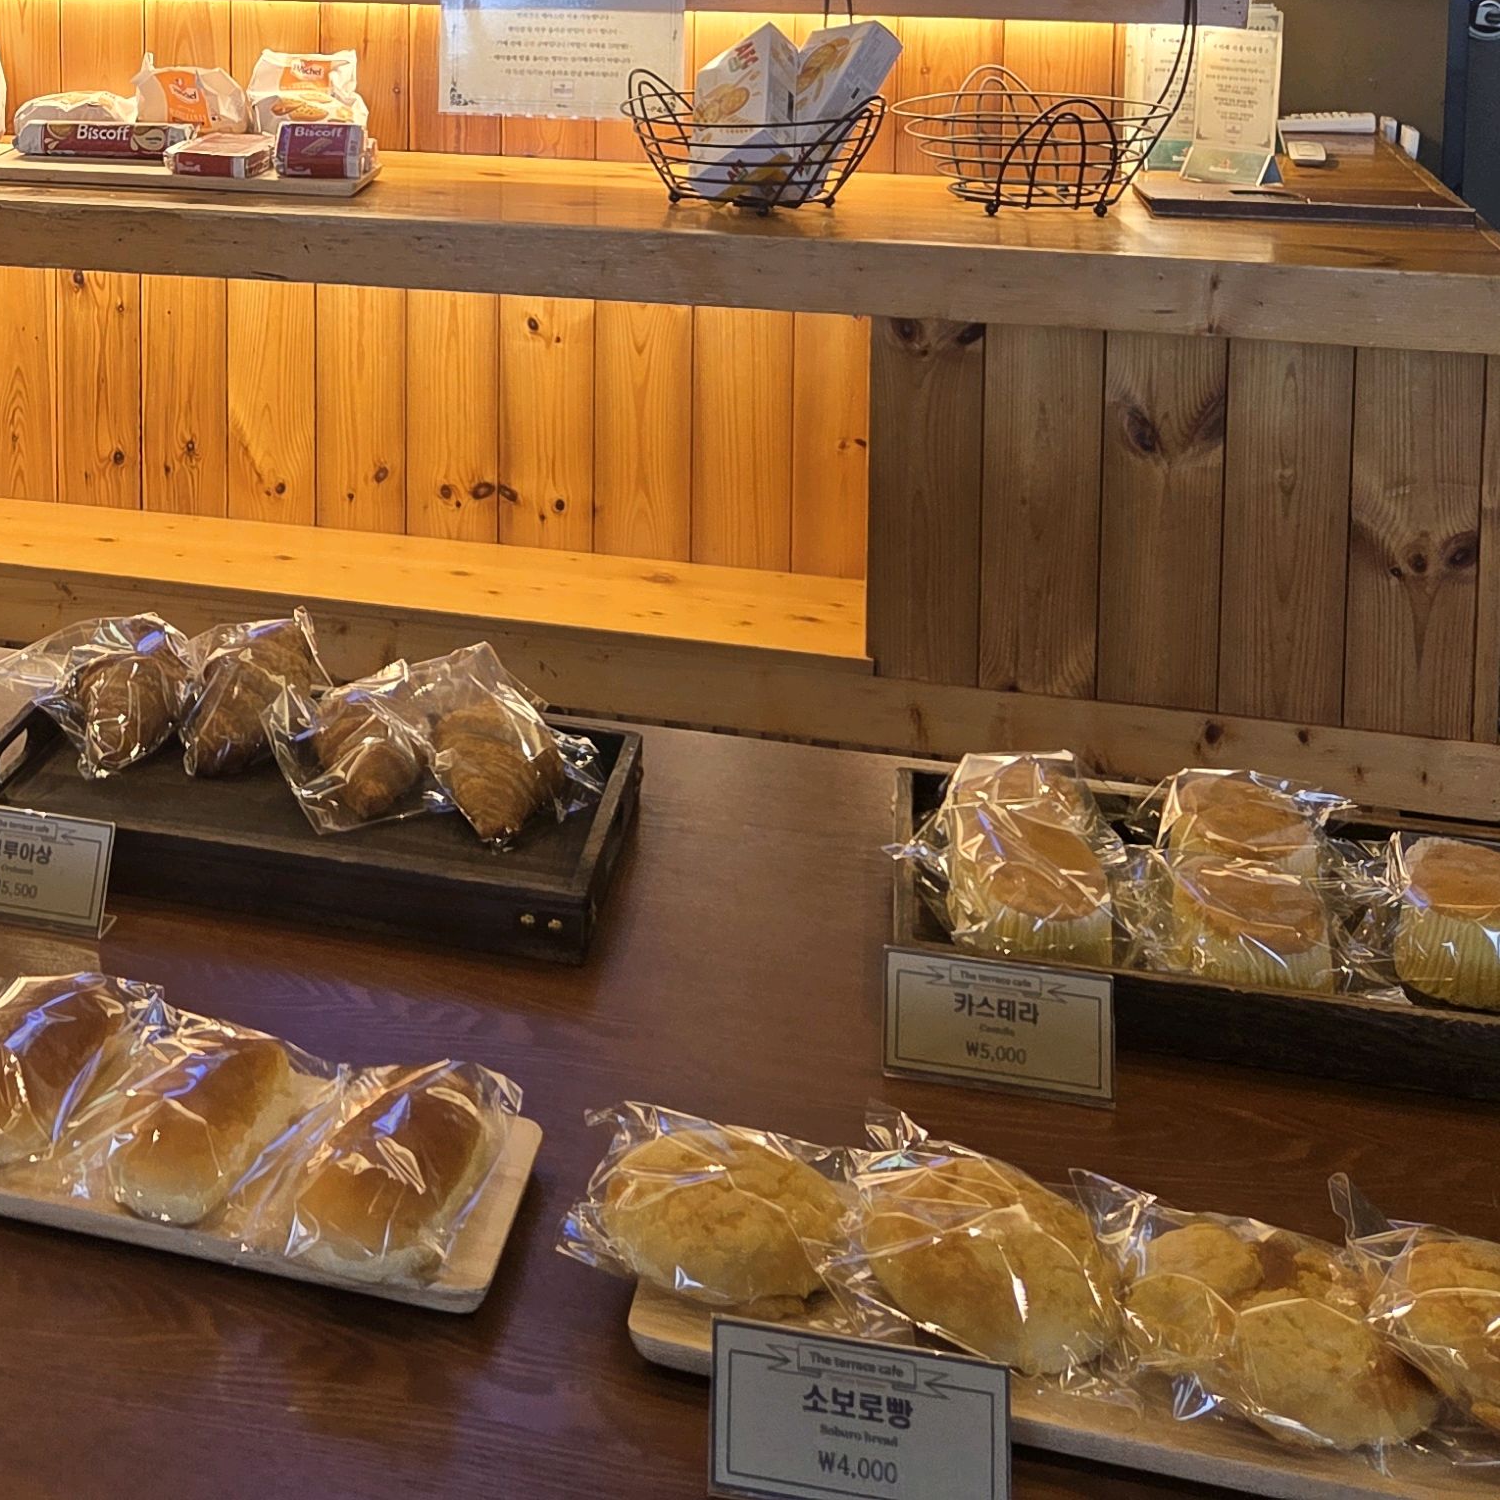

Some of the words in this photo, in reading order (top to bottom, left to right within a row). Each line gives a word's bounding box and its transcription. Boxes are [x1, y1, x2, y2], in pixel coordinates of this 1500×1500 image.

[76, 124, 130, 140] Biscoff
[294, 126, 344, 138] Biscoff
[960, 970, 976, 981] The
[1012, 977, 1032, 988] cafe
[954, 993, 1039, 1025] 카스테라
[810, 1352, 832, 1366] The
[834, 1356, 876, 1374] terrace
[878, 1363, 904, 1378] cafe
[803, 1384, 913, 1430] 소보로빵
